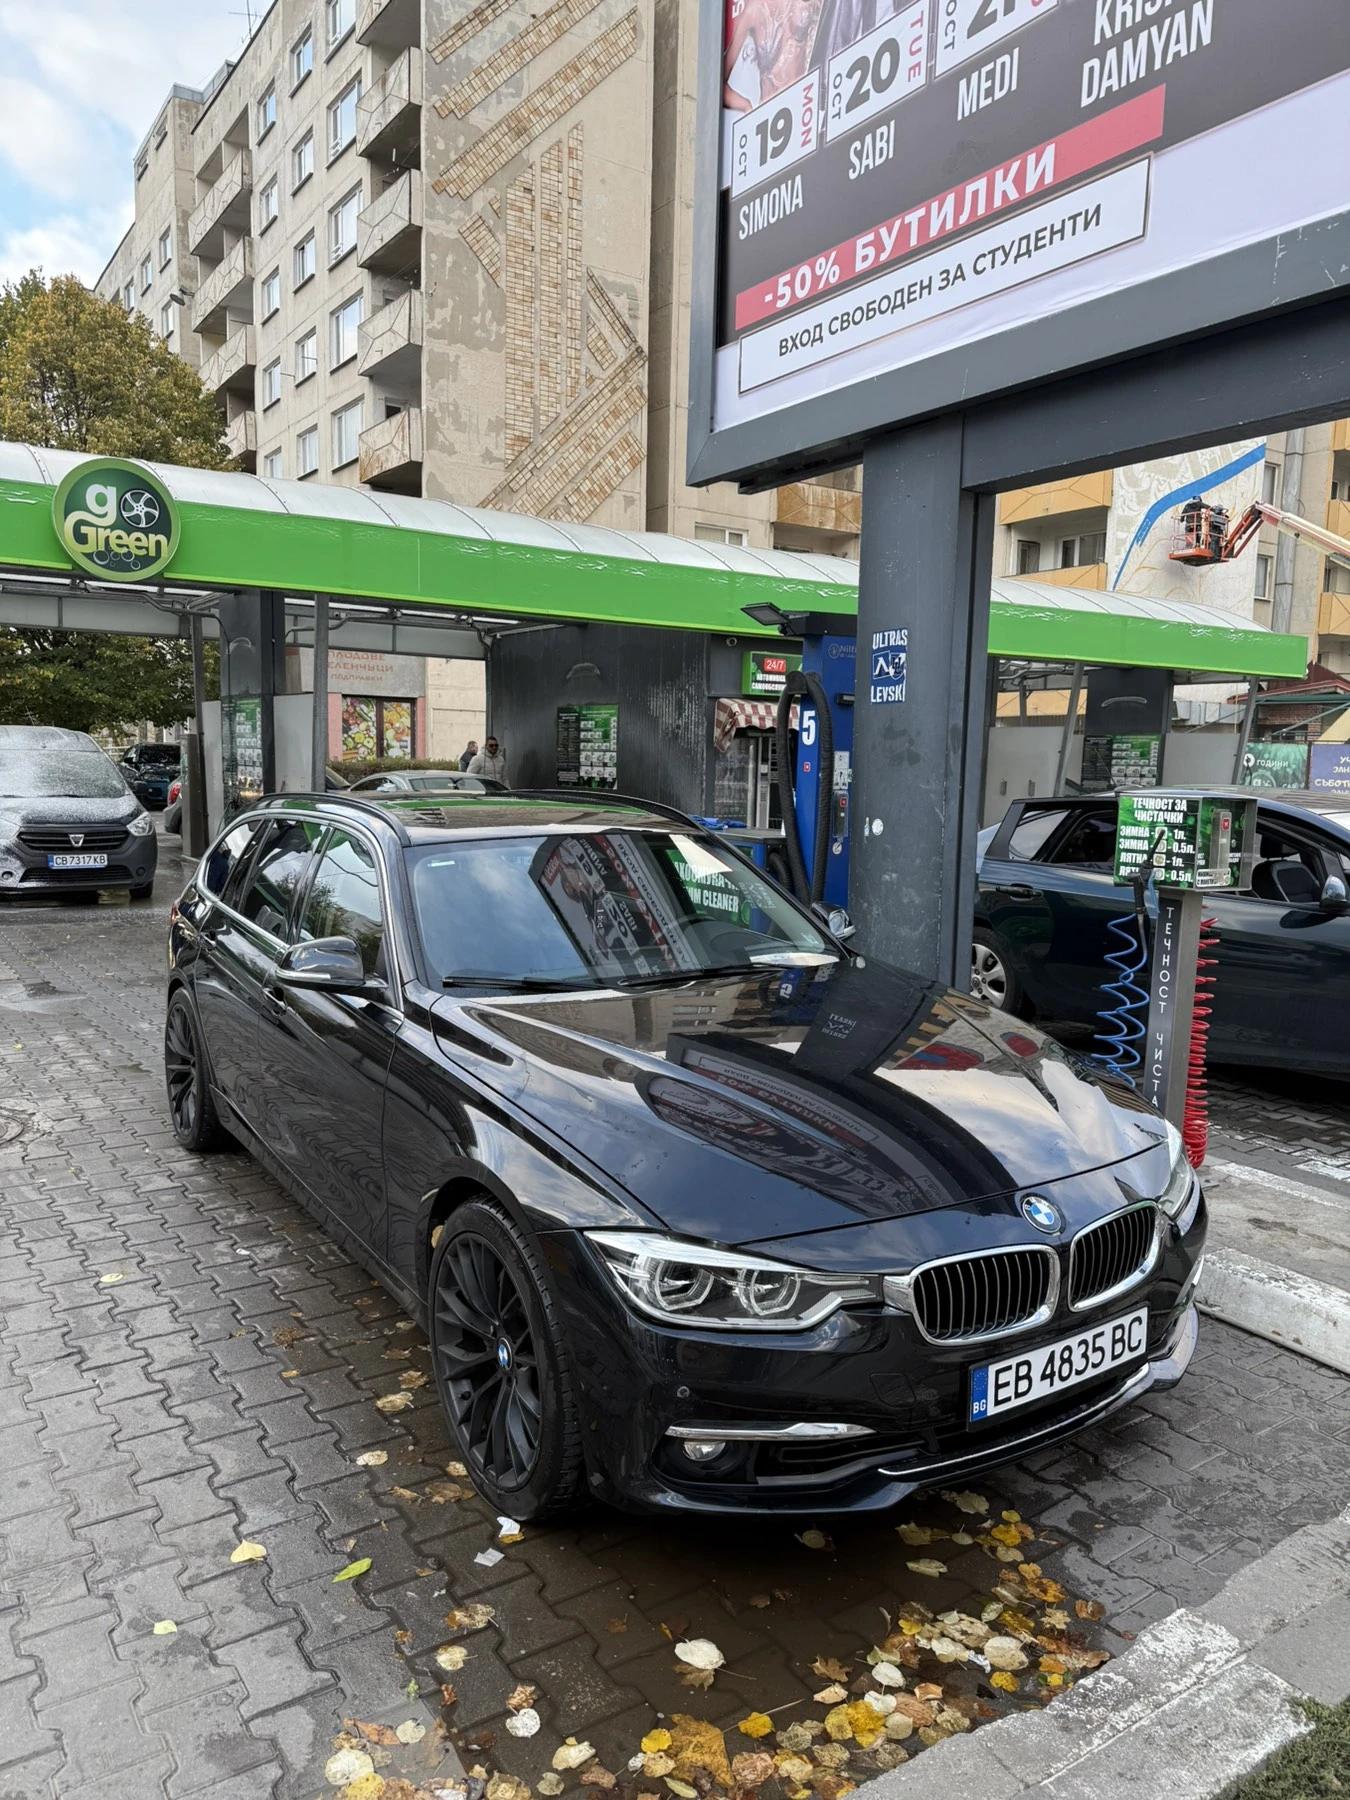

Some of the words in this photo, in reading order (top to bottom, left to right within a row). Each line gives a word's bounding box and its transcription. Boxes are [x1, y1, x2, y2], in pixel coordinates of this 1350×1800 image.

[907, 10, 924, 82] TUE
[944, 0, 957, 50] OCT
[845, 37, 900, 114] 20
[1080, 0, 1213, 108] DAMYAN
[831, 73, 842, 119] OCT
[957, 47, 1019, 121] MEDI
[756, 107, 793, 167] 19
[800, 82, 813, 148] MON
[738, 134, 747, 176] OCT
[849, 120, 895, 180] SABI
[739, 174, 803, 240] SIMONA
[764, 250, 840, 309] -50%
[855, 142, 1056, 273] БУТИЛКИ
[779, 323, 823, 357] ВХОД
[828, 276, 933, 336] СВОБОДЕН
[938, 263, 967, 292] ЗА
[972, 203, 1102, 275] СТУДЕНТИ
[64, 510, 168, 561] Green
[872, 629, 908, 650] ULTRAS
[326, 662, 393, 672] ЕЛЕНЧУЦИ
[766, 659, 785, 670] 24/7
[870, 684, 906, 702] LEVSKI
[802, 710, 816, 746] 5
[1256, 759, 1289, 767] ГОДИНИ
[1315, 778, 1350, 788] СЪБОТ
[1133, 797, 1173, 811] ТЕЧНОСТ
[1175, 799, 1187, 812] ЗА
[1134, 810, 1183, 824] ЧИСТАЧКИ
[1119, 838, 1149, 851] ЗИМНА
[1172, 842, 1195, 854] 0.5л.
[1120, 826, 1149, 838] ЗИМНА
[1170, 870, 1194, 882] 0.5л.
[702, 889, 739, 913] CLEANER
[1158, 906, 1175, 1014] ТЕЧНОСТ
[973, 1399, 986, 1414] BG
[993, 1359, 1033, 1408] EB
[1039, 1330, 1106, 1388] 4835
[1110, 1315, 1143, 1363] BC
